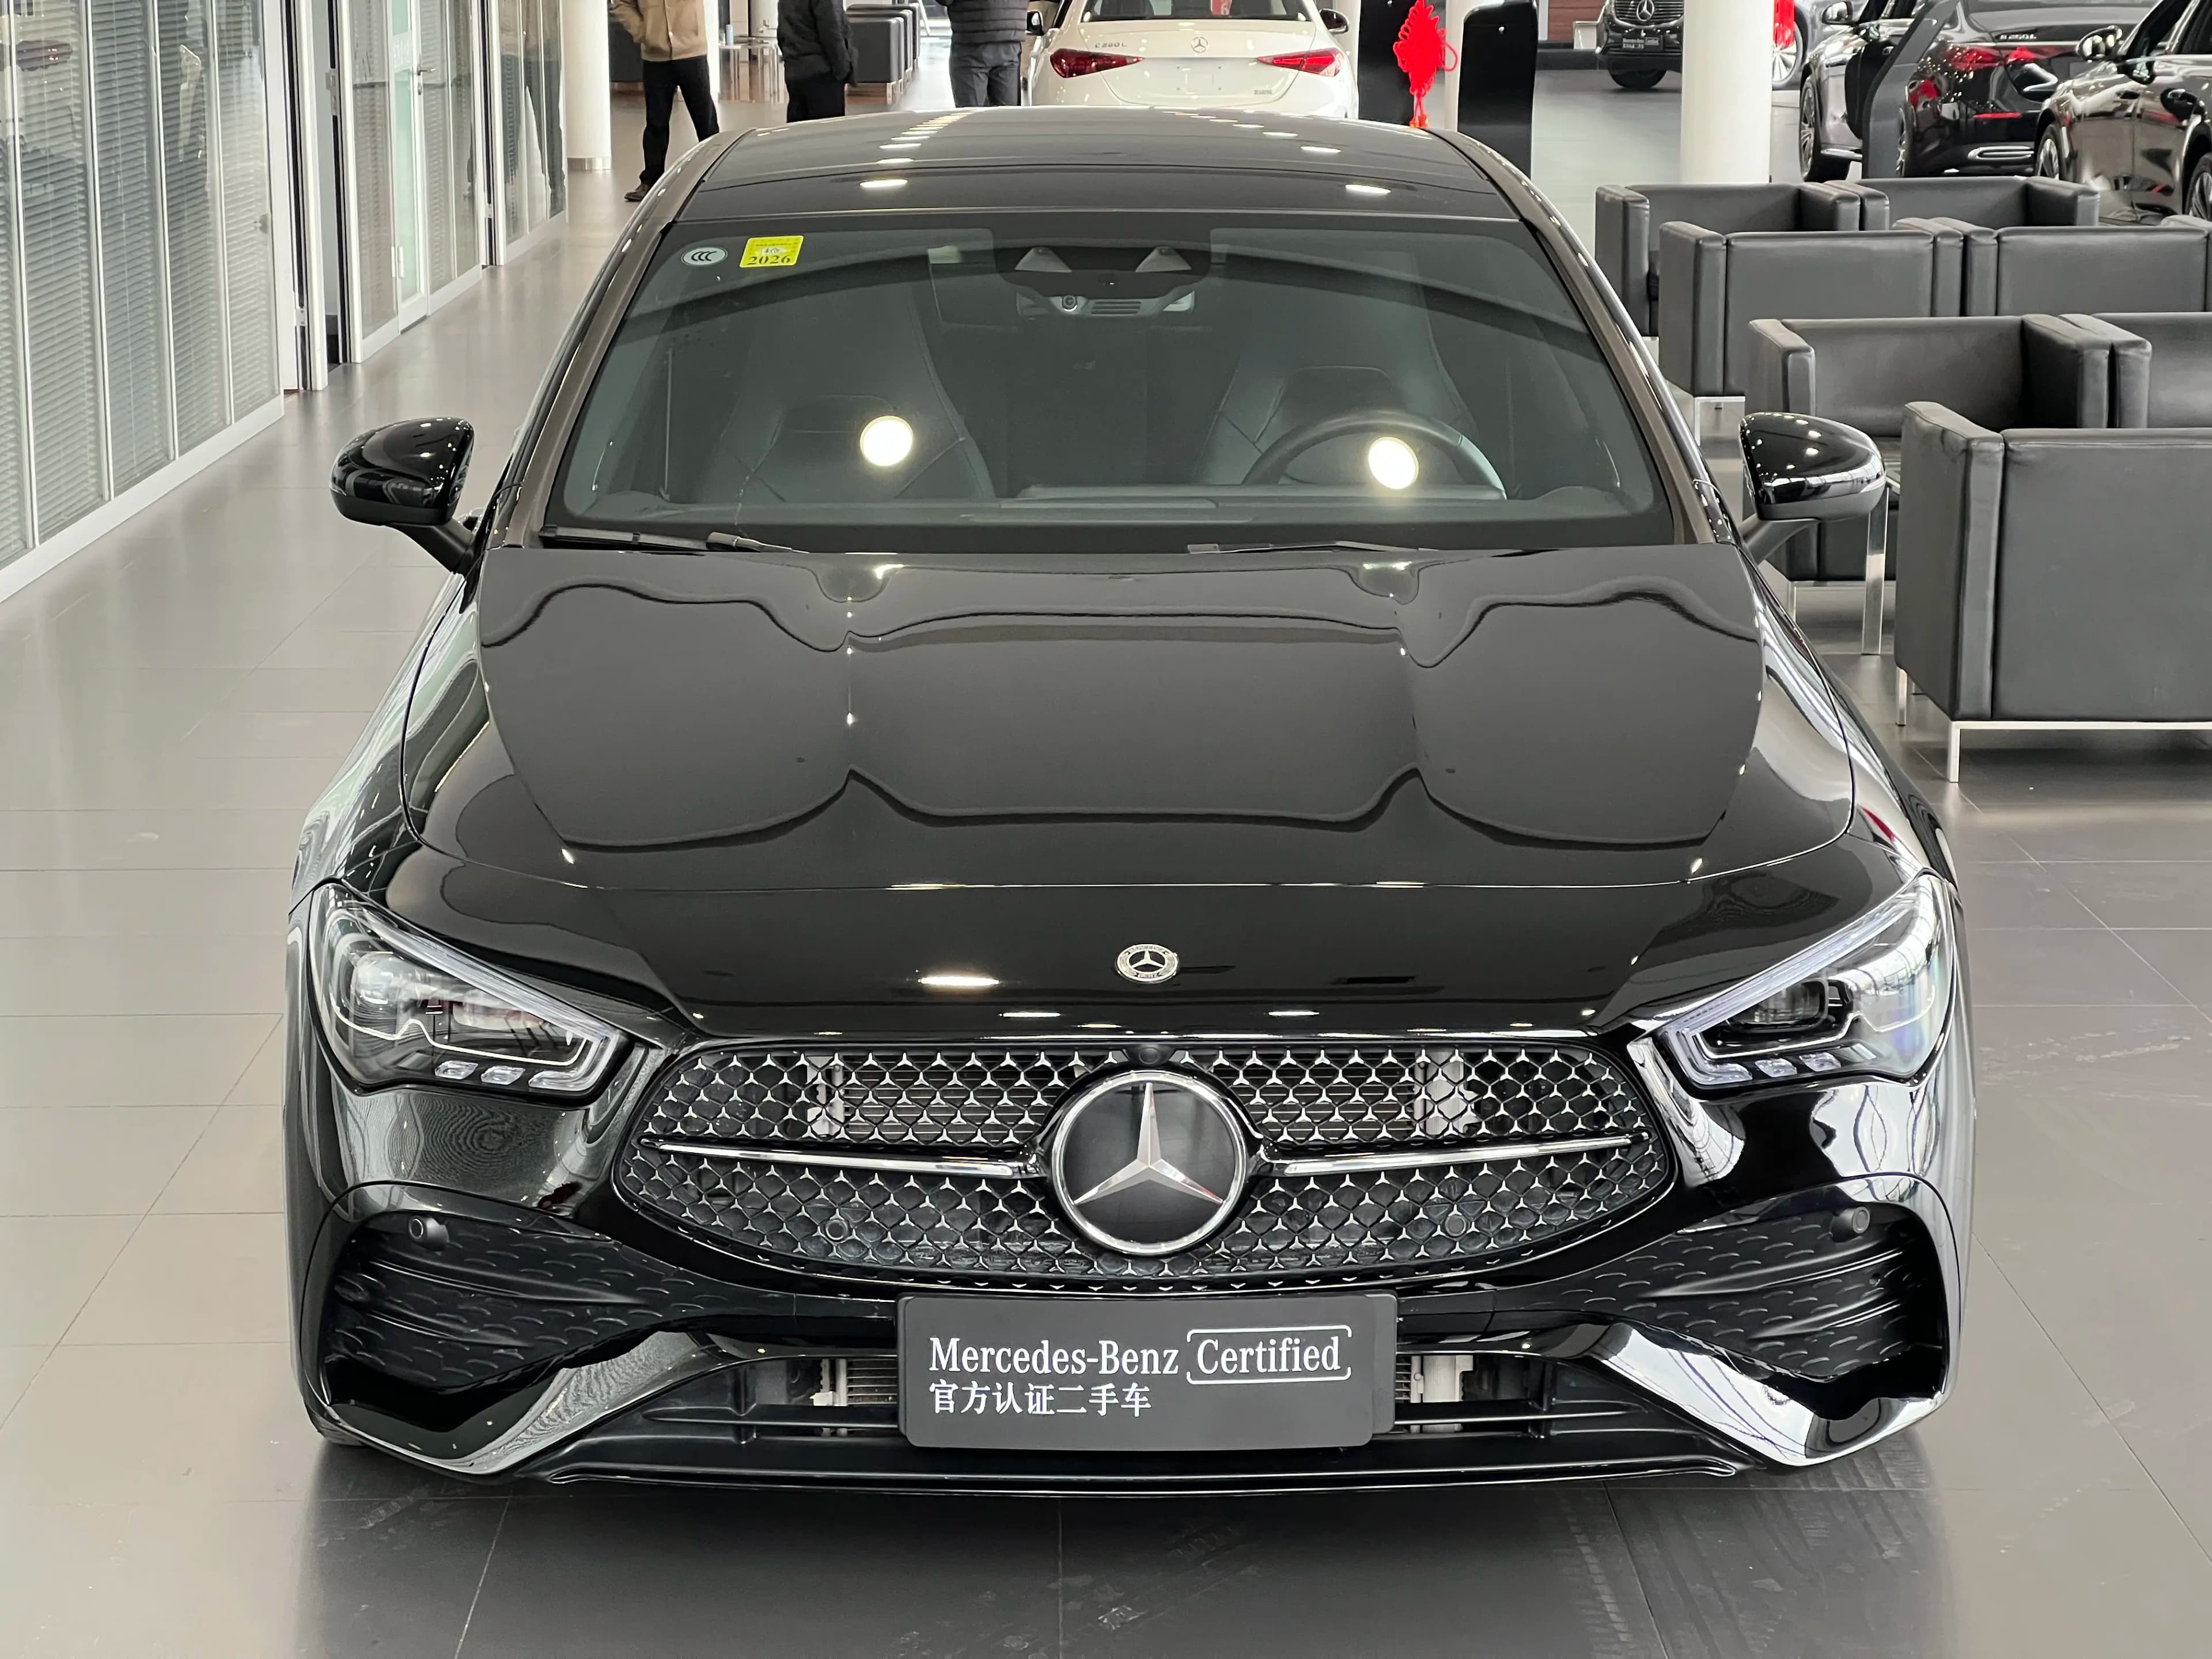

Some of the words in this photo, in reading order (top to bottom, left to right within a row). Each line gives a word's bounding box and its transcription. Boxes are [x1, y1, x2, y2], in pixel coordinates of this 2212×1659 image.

[747, 255, 791, 266] 2026
[929, 1336, 1179, 1375] Mercedes-Benz
[1197, 1335, 1341, 1374] Certified
[929, 1379, 1152, 1417] 官方认证二手车
